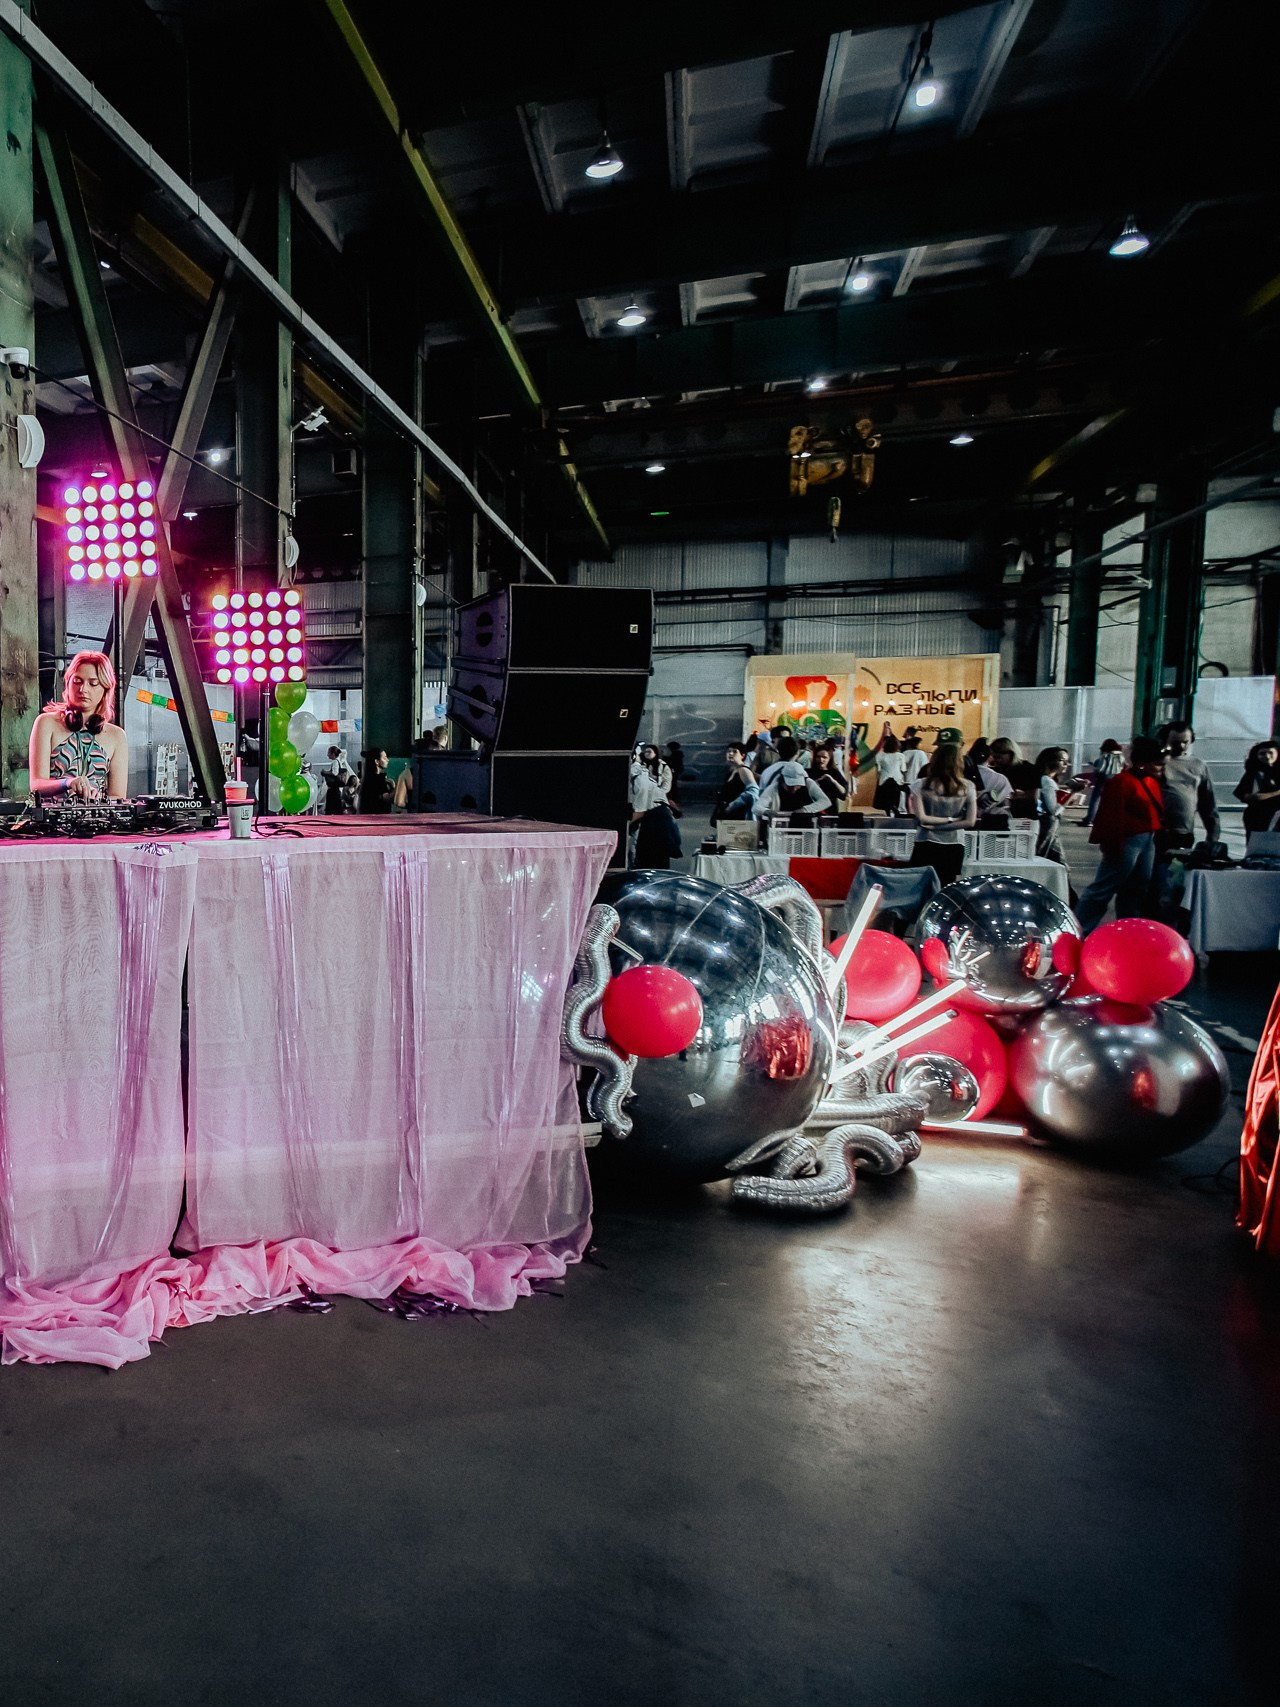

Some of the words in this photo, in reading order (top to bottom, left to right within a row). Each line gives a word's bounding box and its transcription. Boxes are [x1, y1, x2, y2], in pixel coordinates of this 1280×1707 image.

[886, 682, 921, 695] ВСЕ
[921, 689, 977, 702] ЛЮДИ
[873, 703, 955, 715] РАЗНЫЕ
[159, 801, 202, 809] ZVUKOHOD
